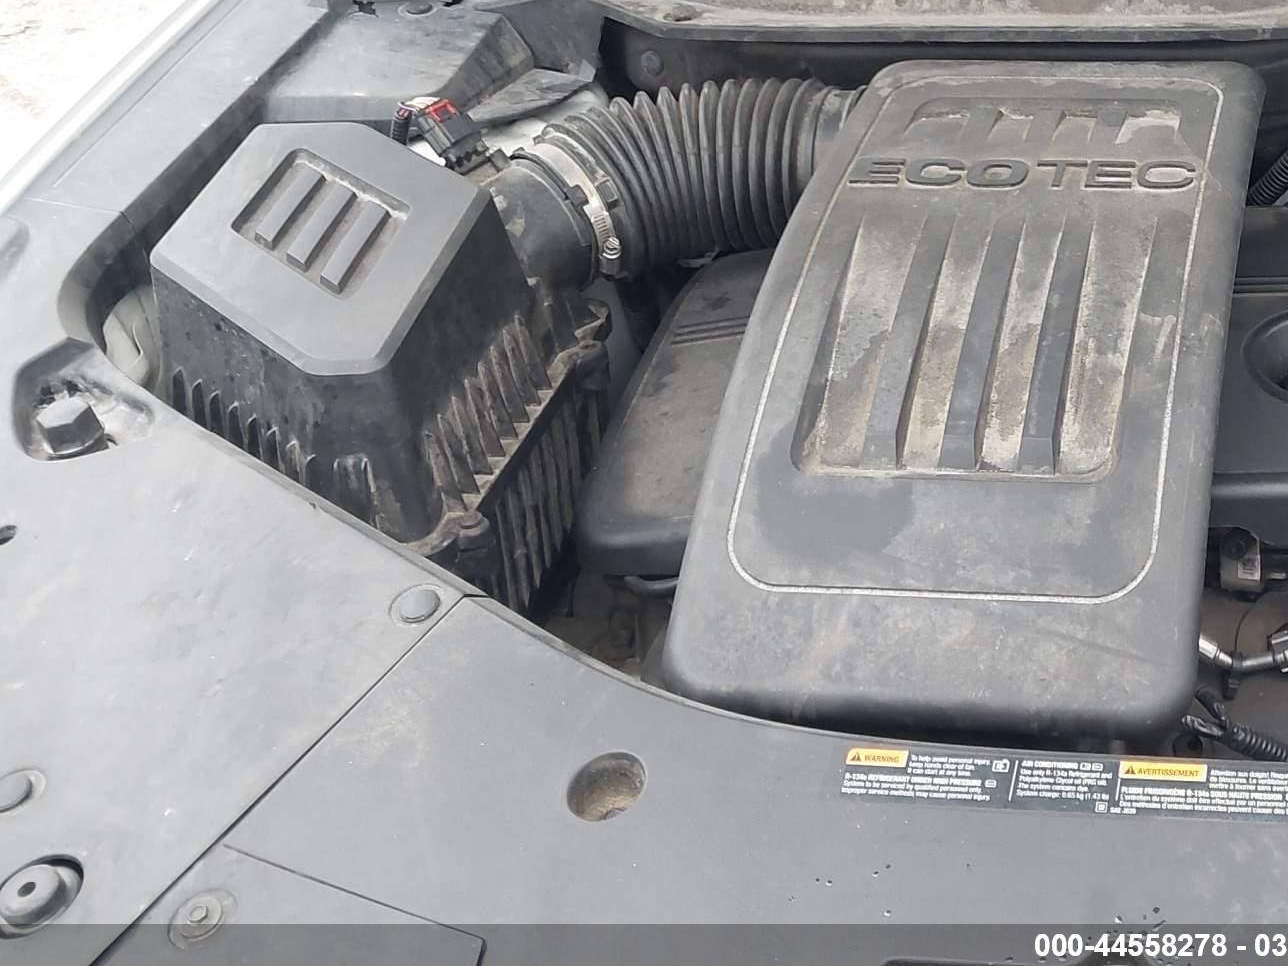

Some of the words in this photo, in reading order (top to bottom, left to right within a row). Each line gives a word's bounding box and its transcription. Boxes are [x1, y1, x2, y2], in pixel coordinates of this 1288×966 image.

[847, 158, 1196, 190] ECOTEC
[864, 755, 899, 763] WARNING
[1138, 767, 1200, 777] AVERTISSEMENT
